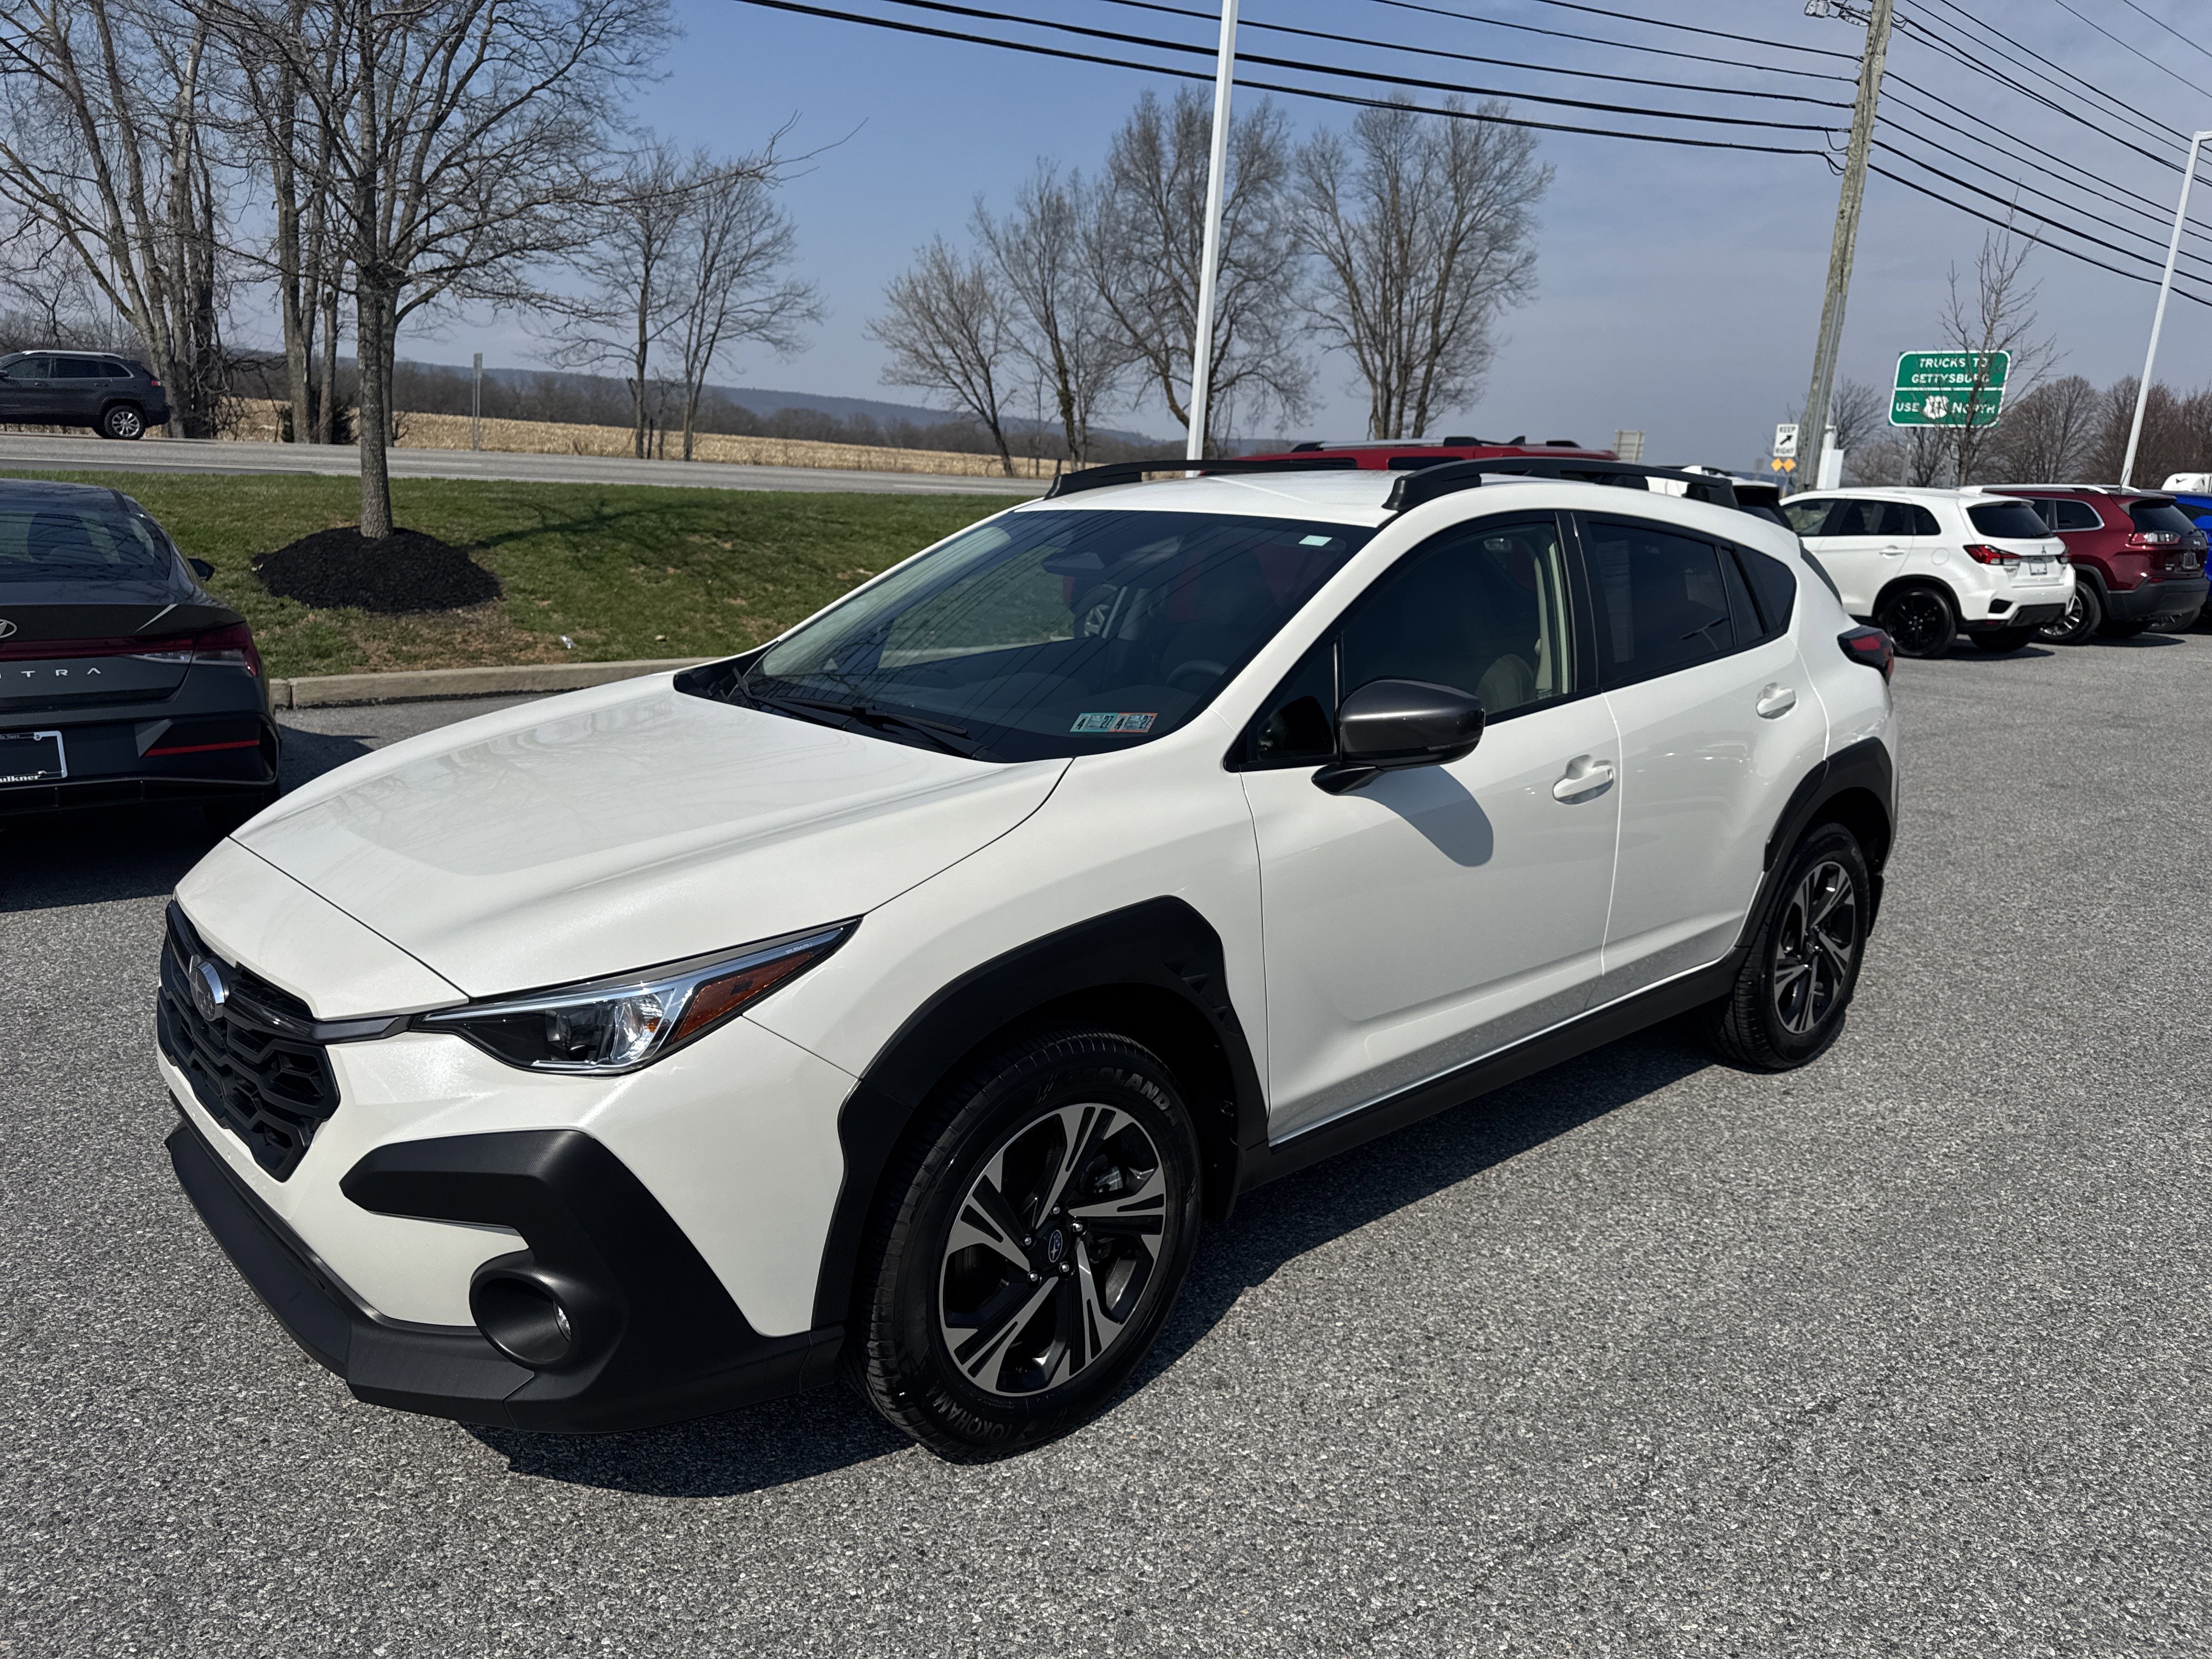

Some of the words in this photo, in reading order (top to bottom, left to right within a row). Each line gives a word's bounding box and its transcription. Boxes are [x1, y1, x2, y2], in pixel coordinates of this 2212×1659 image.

[1919, 358, 1966, 368] TRUCKS
[1972, 357, 1988, 368] TO
[1895, 402, 1920, 413] USE
[0, 667, 101, 679] TRA
[1077, 718, 1086, 730] 4
[1099, 715, 1115, 729] 27
[1115, 718, 1125, 730] 4
[1138, 715, 1154, 729] 27
